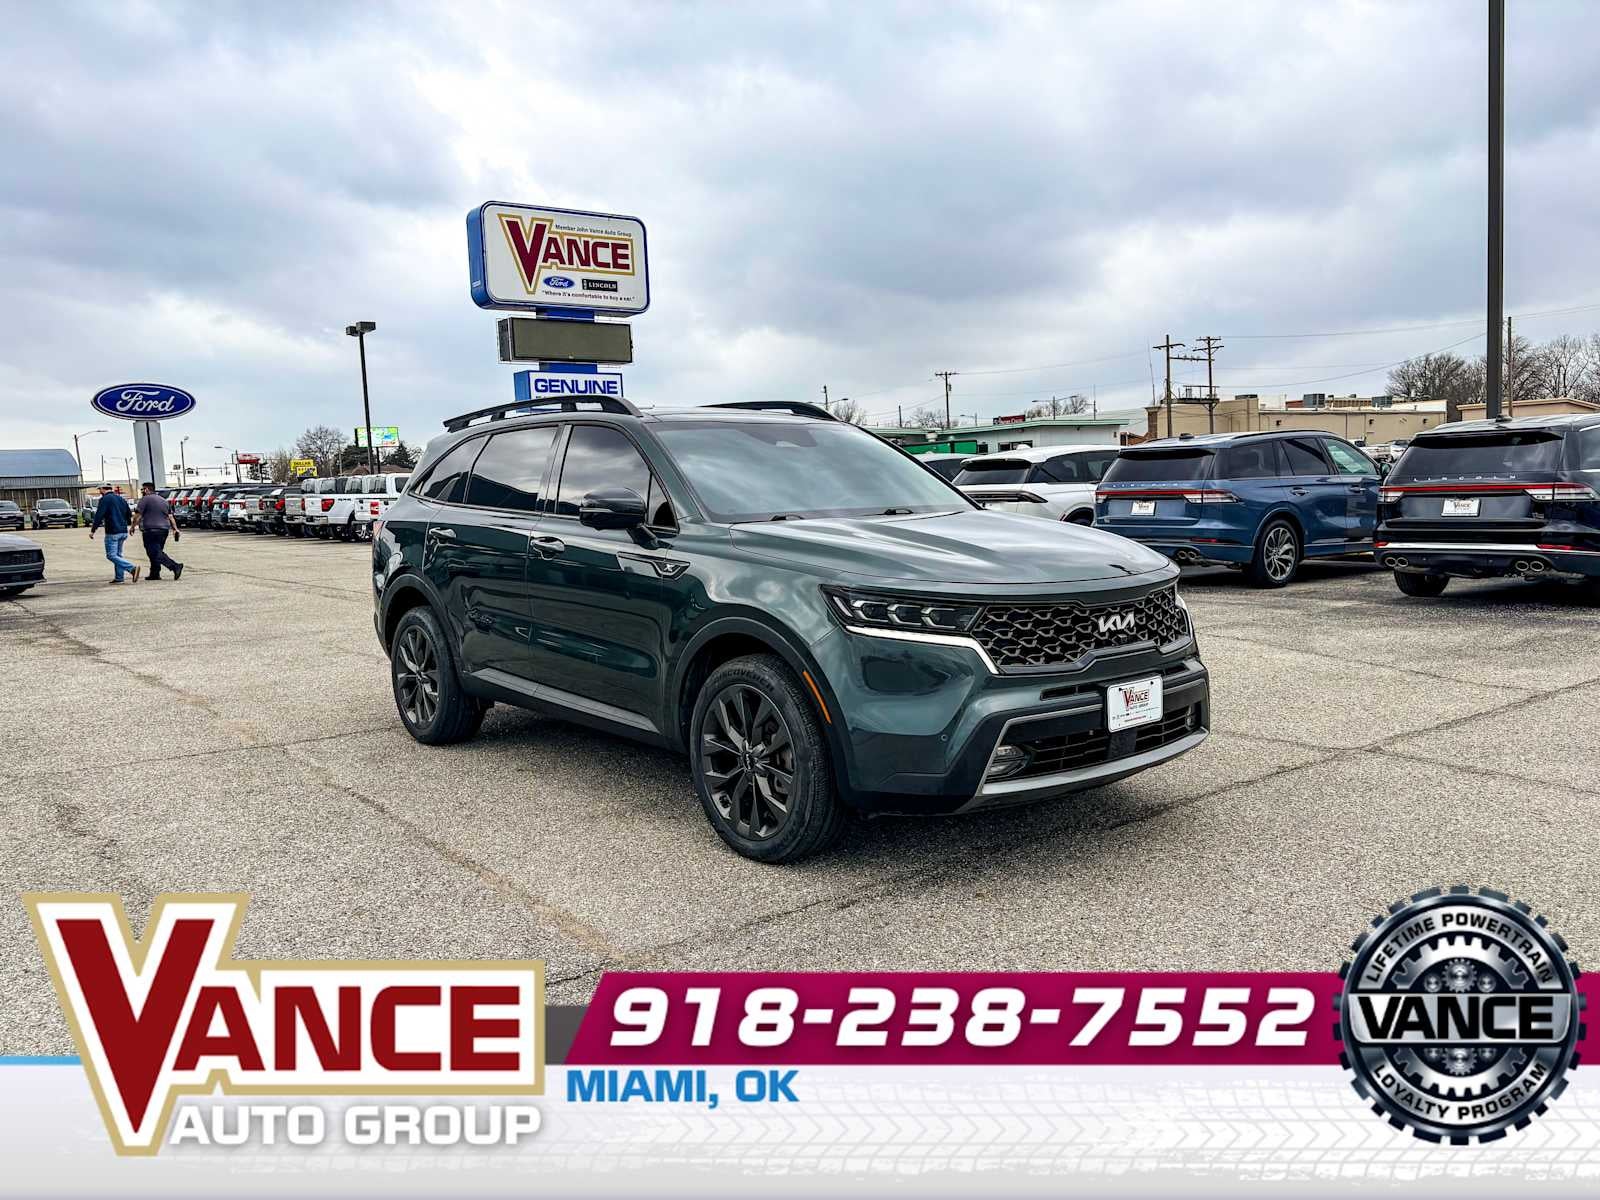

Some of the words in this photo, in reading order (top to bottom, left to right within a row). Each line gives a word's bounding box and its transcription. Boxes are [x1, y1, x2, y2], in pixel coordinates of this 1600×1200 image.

[616, 230, 632, 238] Group
[504, 219, 631, 289] VANCE
[549, 277, 569, 288] Ford
[588, 281, 617, 290] LINCOLN
[571, 291, 603, 300] comfortable
[534, 378, 618, 394] GENUINE
[116, 389, 175, 412] Ford
[1098, 611, 1135, 633] KIA
[1123, 690, 1149, 707] VANCE
